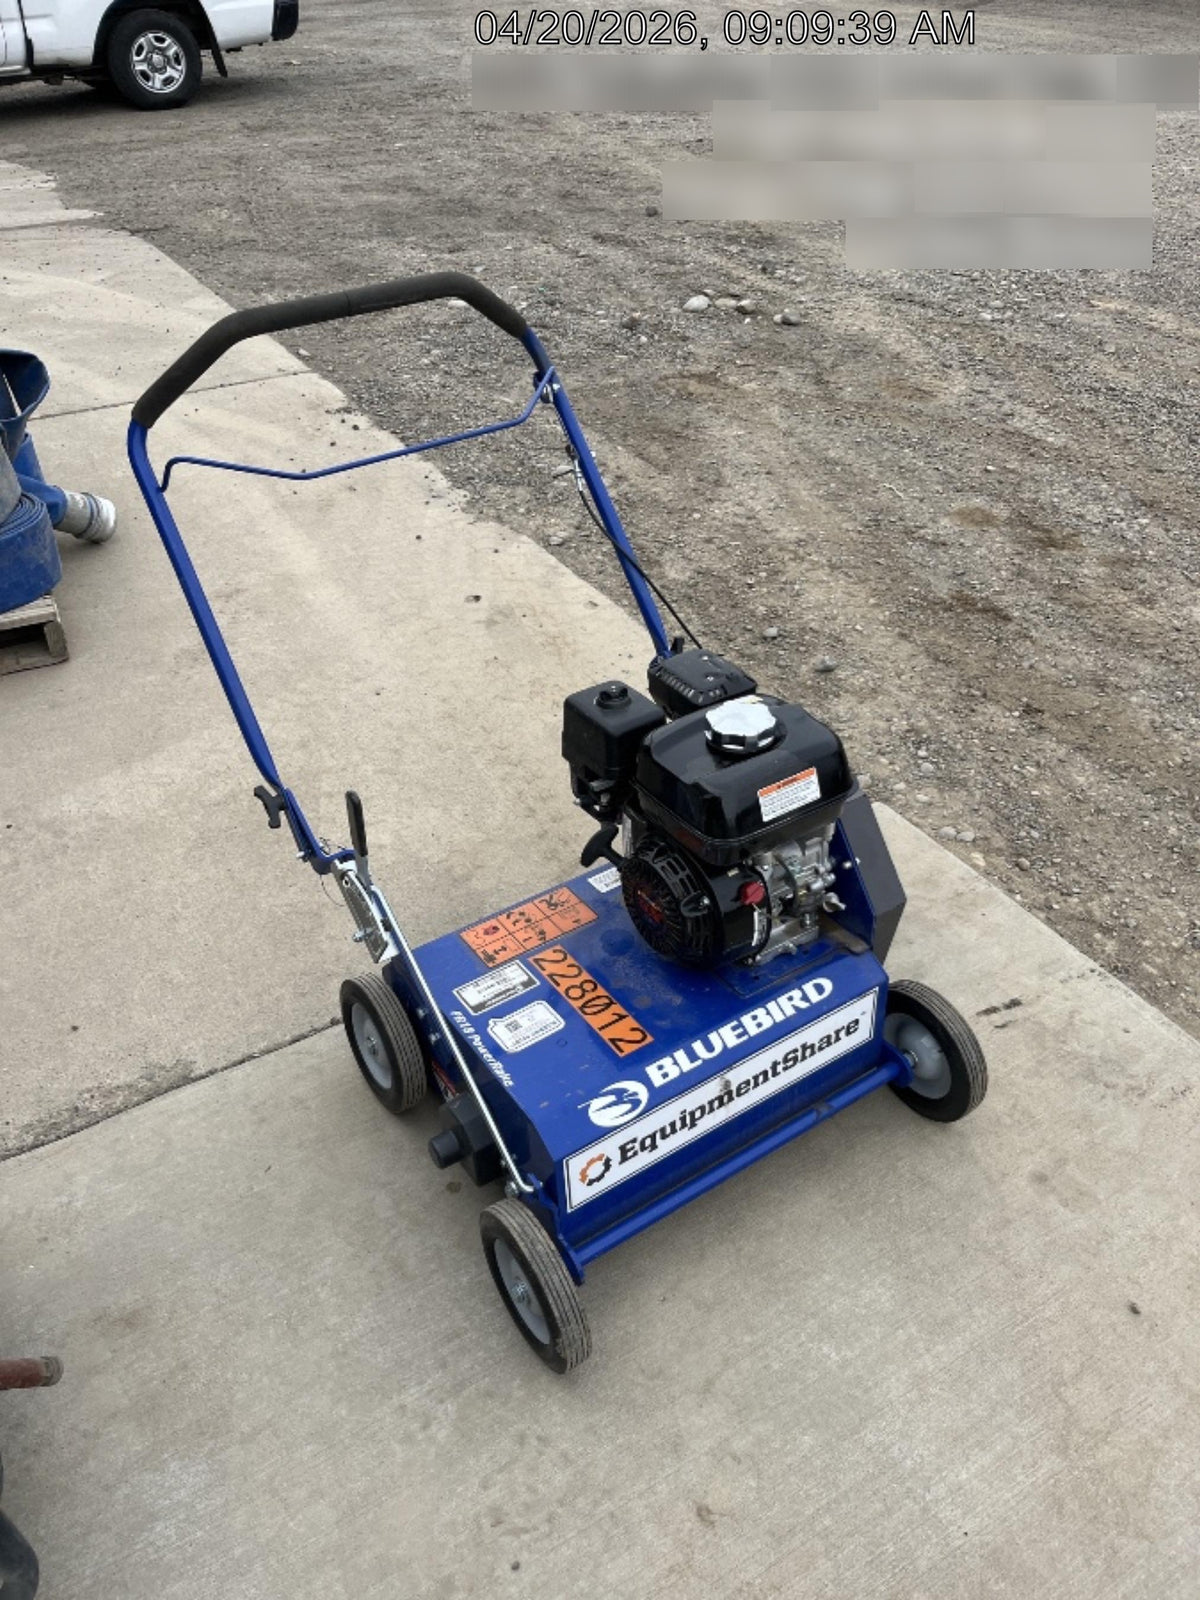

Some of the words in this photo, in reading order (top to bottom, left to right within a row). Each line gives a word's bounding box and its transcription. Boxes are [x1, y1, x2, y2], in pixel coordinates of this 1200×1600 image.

[533, 948, 648, 1054] 228012
[645, 977, 834, 1088] BLUEBIRD
[618, 1018, 860, 1165] EquipmentShare
